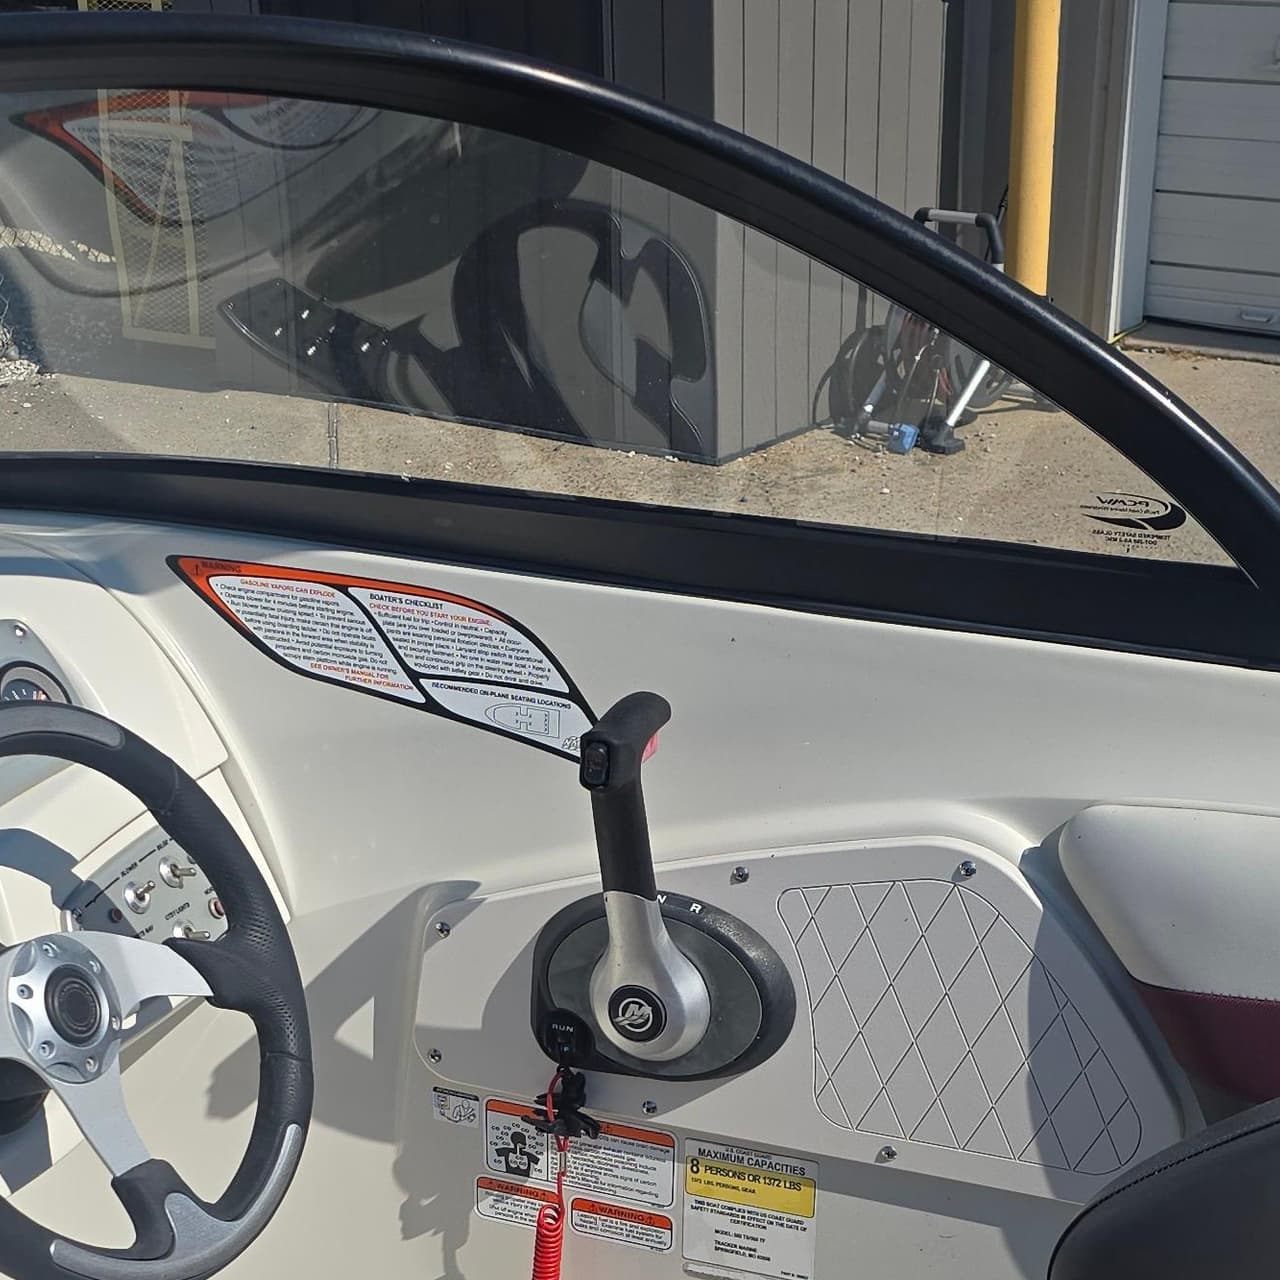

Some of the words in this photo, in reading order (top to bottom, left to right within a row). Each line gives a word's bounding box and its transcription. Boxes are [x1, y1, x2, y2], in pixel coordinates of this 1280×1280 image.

[295, 586, 308, 594] CAN
[369, 603, 388, 611] CHECK
[391, 606, 414, 614] BEFORE
[430, 611, 448, 619] START
[404, 598, 442, 609] CHECKLIST
[351, 668, 374, 677] MANUAL
[431, 682, 478, 694] RECOMMENDED
[510, 694, 535, 703] SEATING
[537, 698, 571, 709] LOCATIONS
[690, 903, 702, 914] R
[552, 1024, 574, 1032] RUN
[698, 1148, 744, 1165] MAXIMUM
[747, 1157, 805, 1176] CAPACITIES
[690, 1157, 699, 1174] 8
[704, 1165, 746, 1180] PERSONS
[747, 1173, 760, 1183] OR
[763, 1176, 781, 1187] 1372
[783, 1180, 801, 1191] LBS
[496, 1182, 538, 1197] WARNING
[598, 1205, 644, 1221] WARNING
[690, 1204, 708, 1213] SAFETY
[710, 1208, 739, 1219] STANDARDS
[747, 1215, 765, 1224] EFFECT
[706, 1201, 720, 1209] BOAT
[721, 1204, 745, 1214] COMPLIES
[768, 1213, 785, 1221] COAST
[729, 1218, 767, 1230] CERTIFICATION
[714, 1239, 737, 1249] TRACKER
